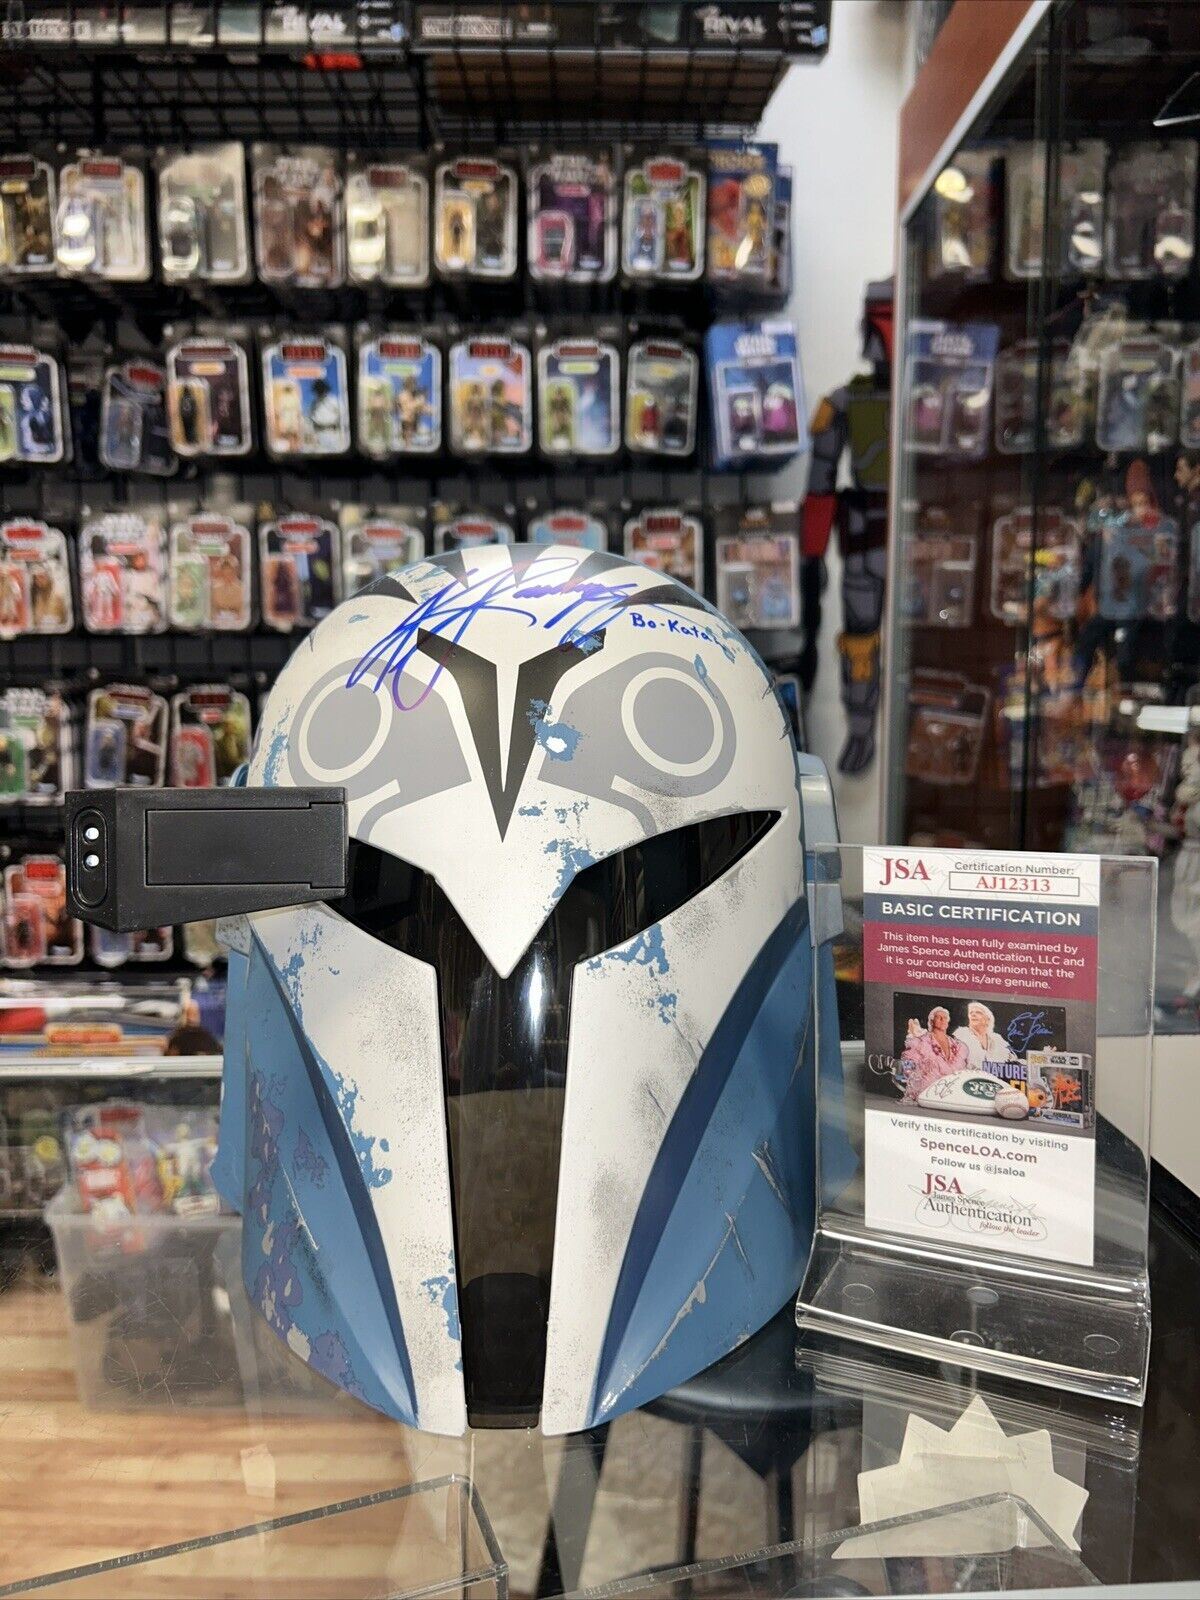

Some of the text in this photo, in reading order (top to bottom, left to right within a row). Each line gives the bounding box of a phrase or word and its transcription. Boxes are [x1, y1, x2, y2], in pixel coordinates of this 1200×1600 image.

[879, 857, 932, 886] JSA
[954, 862, 1075, 875] Certification Number:
[975, 875, 1051, 892] AJ12313
[882, 902, 1081, 926] BASIC CERTIFICATION
[877, 943, 1085, 967] James Spence Authentication, LLC and
[883, 931, 1078, 955] This item has been fully examined by
[885, 955, 1075, 979] it is our considered opinion that the
[907, 969, 1052, 990] signature(s) is/are genuine.
[982, 1060, 1028, 1080] NATURE
[890, 1118, 1069, 1152] Verify this certification by visiting
[920, 1137, 1038, 1164] SpenceLOA.com
[930, 1156, 1026, 1178] Follow us @jsaloa
[921, 1172, 964, 1196] JSA
[932, 1191, 956, 1202] James
[923, 1197, 1033, 1227] Authentication
